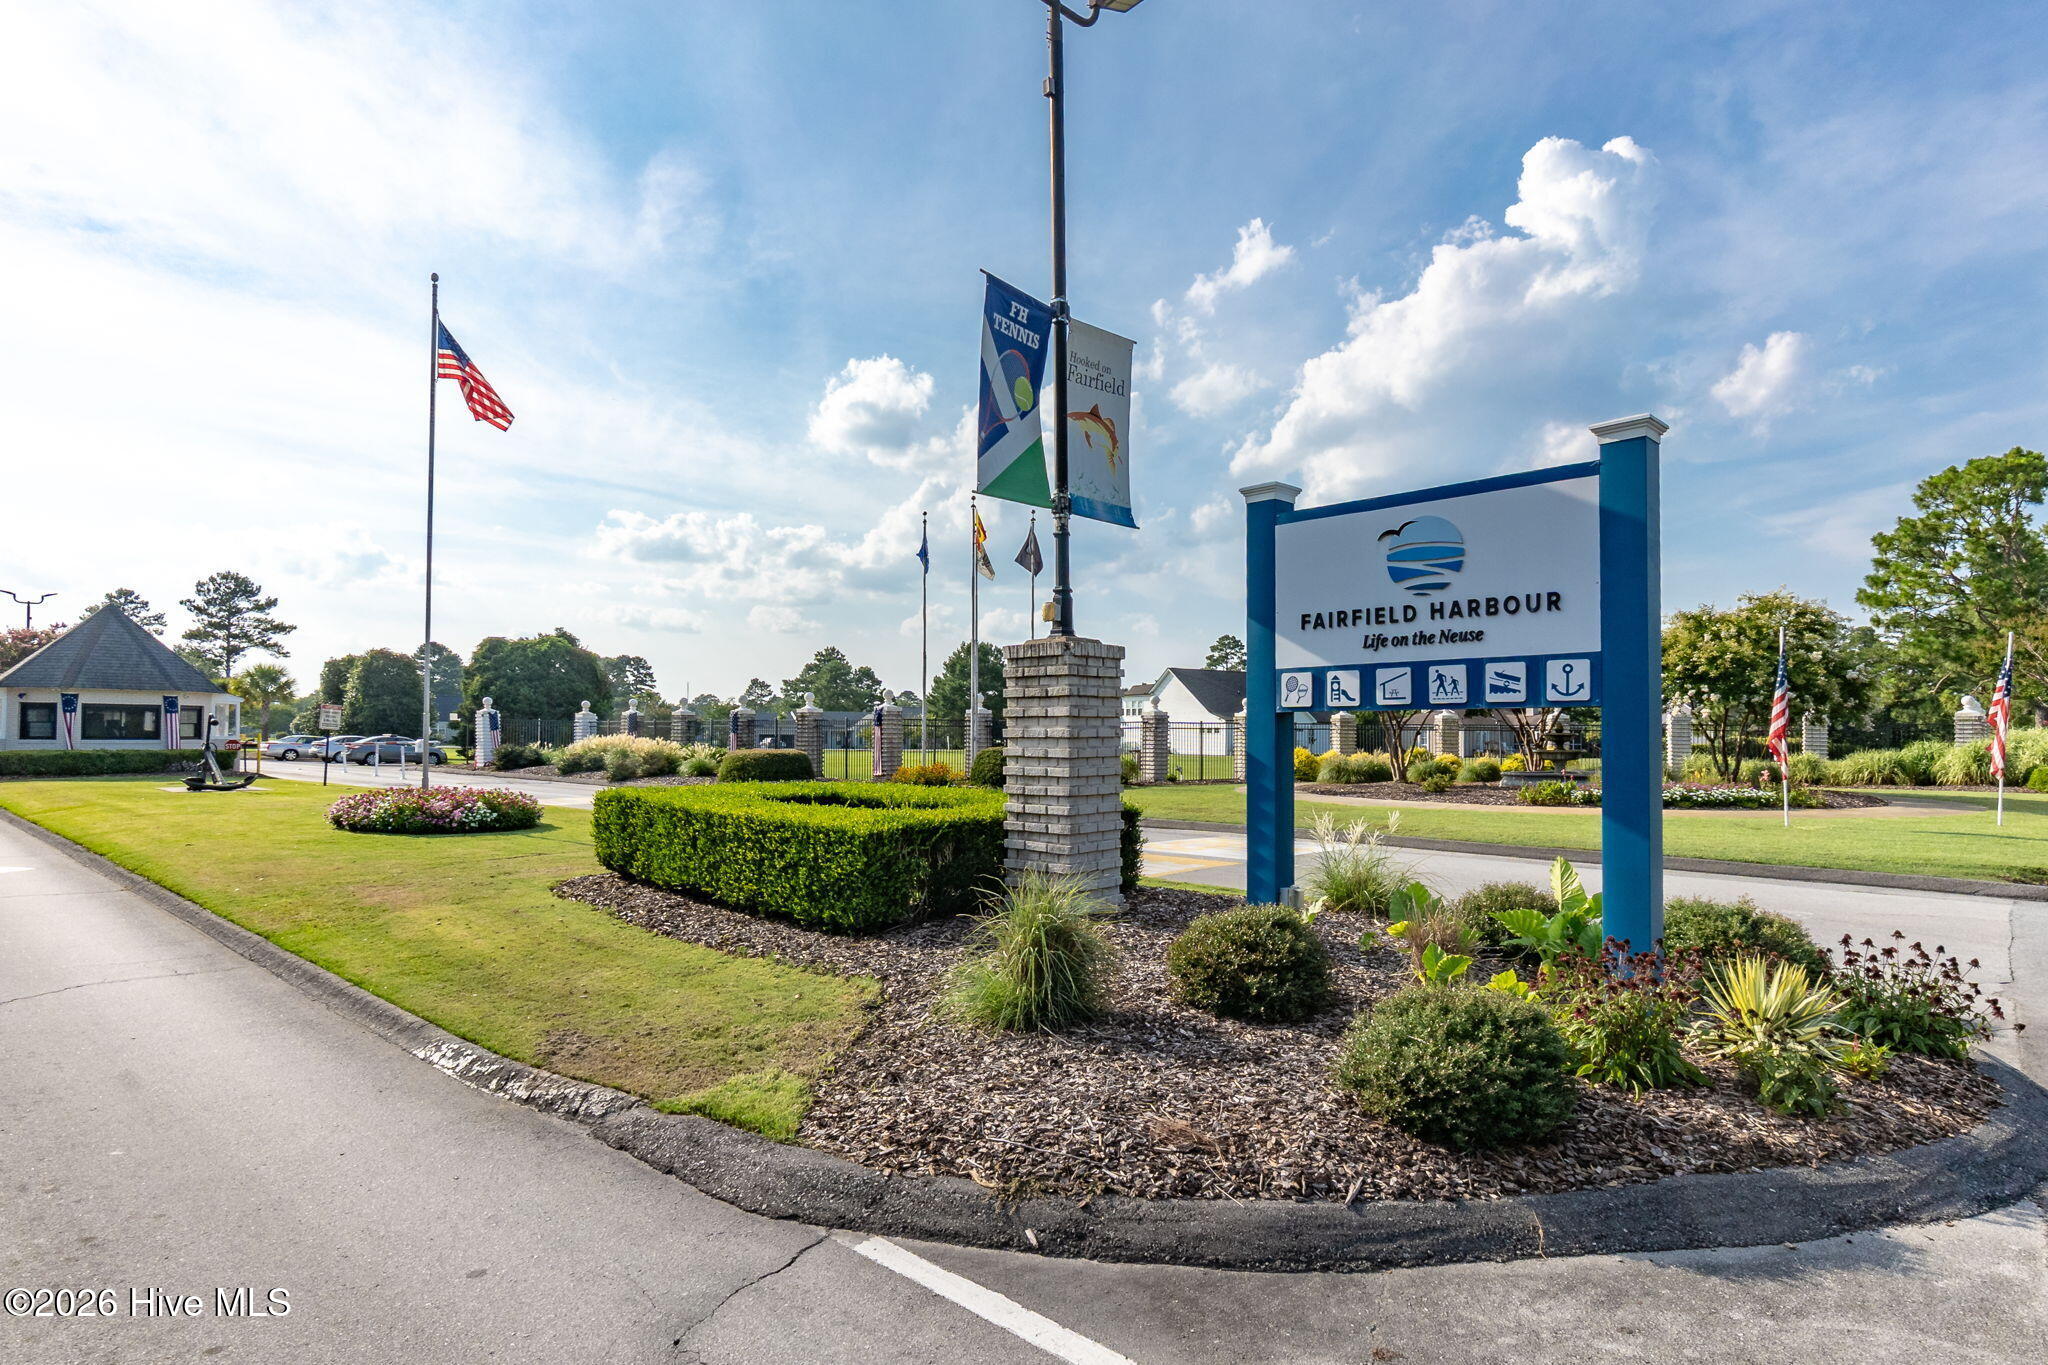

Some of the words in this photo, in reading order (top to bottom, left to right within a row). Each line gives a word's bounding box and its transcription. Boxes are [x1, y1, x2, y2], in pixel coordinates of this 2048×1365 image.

[1009, 301, 1029, 323] FH
[993, 313, 1040, 349] TENNIS
[1069, 351, 1101, 371] Hooked
[1102, 365, 1112, 375] on
[1067, 362, 1126, 397] Fairfield
[1300, 605, 1417, 630] FAIRFIELD
[1430, 591, 1562, 620] HARBOUR
[1362, 633, 1388, 651] Life
[1391, 636, 1410, 647] on
[1411, 630, 1436, 646] the
[1439, 629, 1485, 644] Neuse
